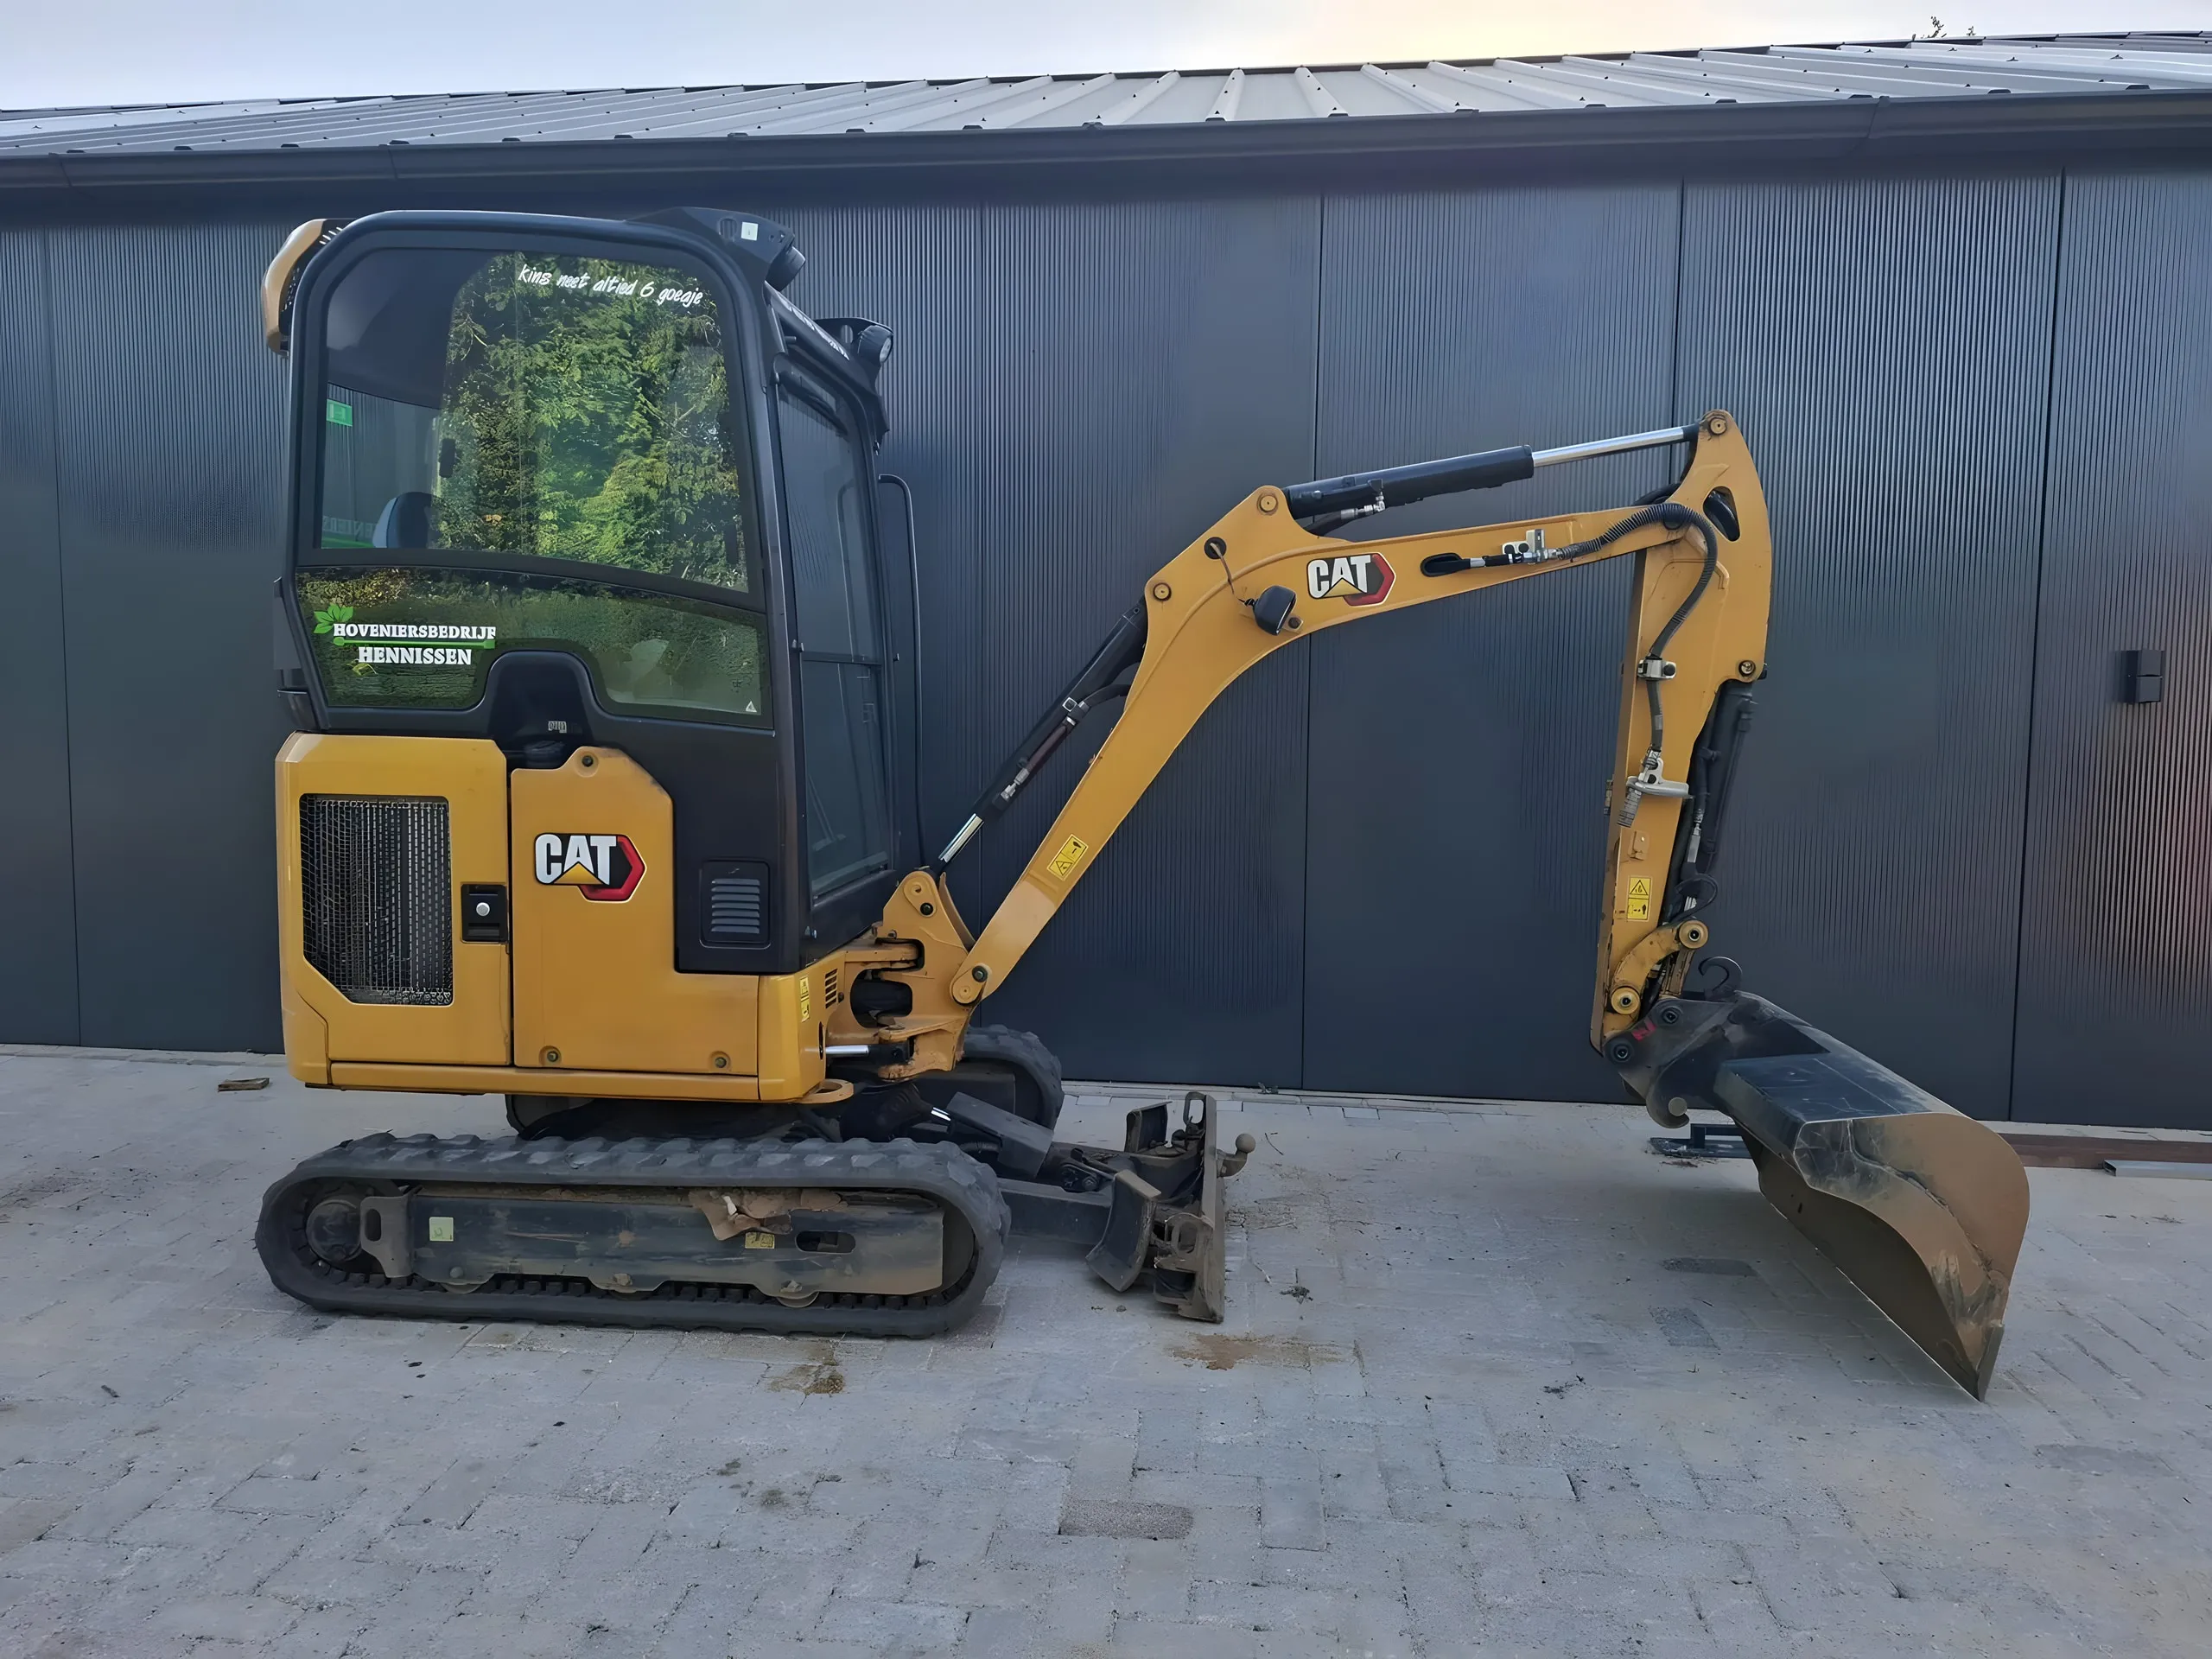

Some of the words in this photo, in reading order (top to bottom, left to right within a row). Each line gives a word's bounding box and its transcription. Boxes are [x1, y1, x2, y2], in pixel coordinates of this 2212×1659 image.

[593, 275, 638, 296] altied
[1307, 554, 1371, 598] CAT
[358, 646, 472, 664] HENNISSEN
[535, 834, 616, 885] CAT
